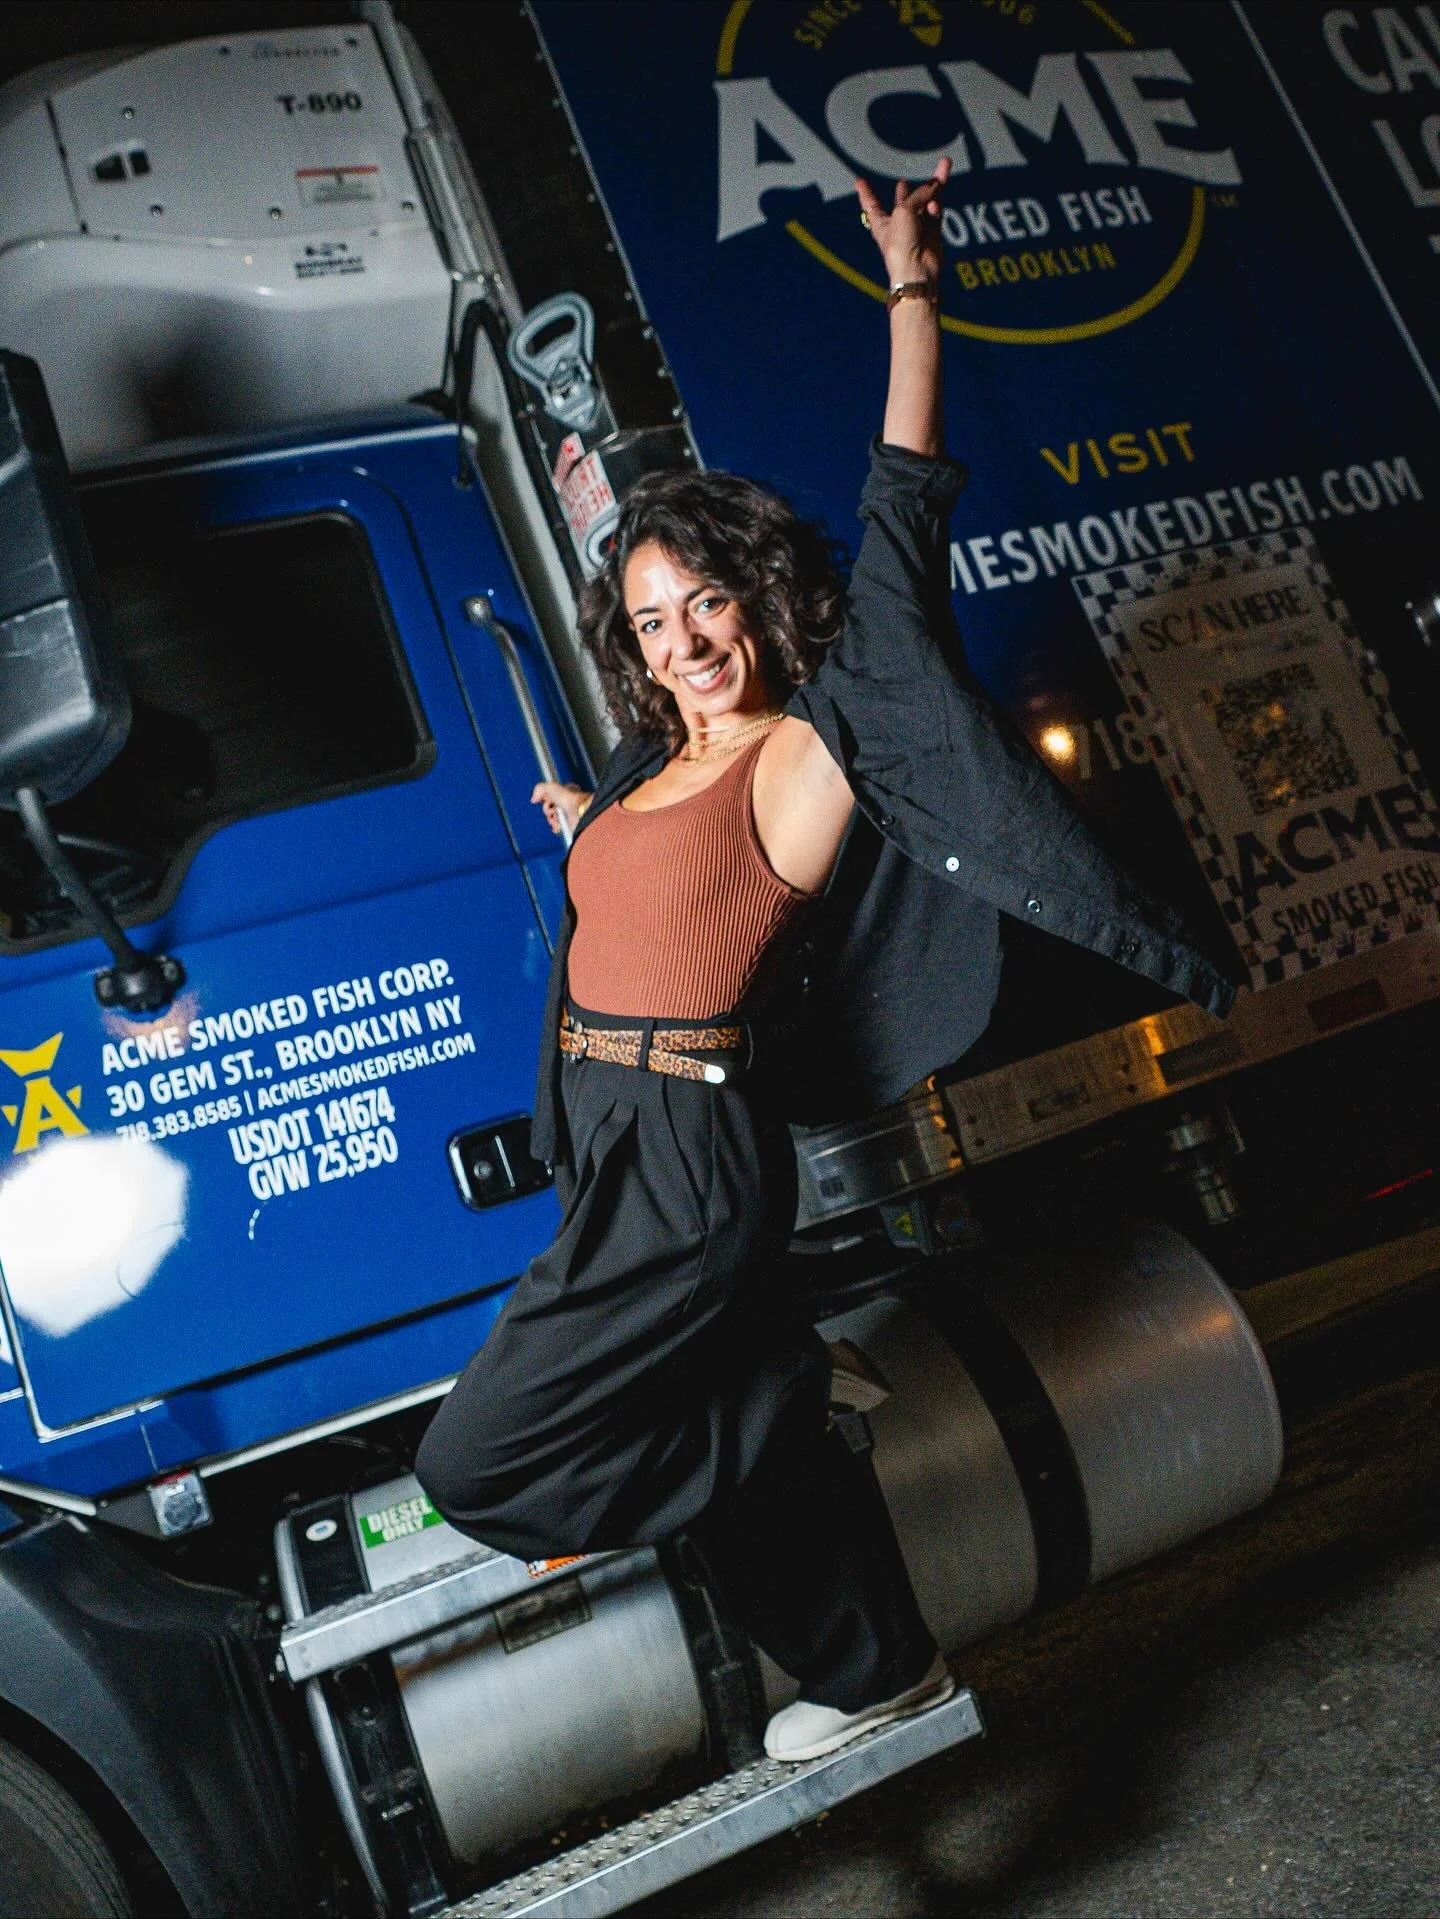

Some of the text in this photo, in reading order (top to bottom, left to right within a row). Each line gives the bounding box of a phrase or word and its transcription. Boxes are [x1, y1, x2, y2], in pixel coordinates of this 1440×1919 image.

[278, 91, 362, 115] T-890
[713, 49, 1242, 243] ACME
[941, 185, 1153, 248] OKED FISH
[954, 242, 1116, 290] BROOKLYN
[1040, 422, 1199, 485] VISIT
[949, 456, 1423, 594] ESMOKEDFISH.COM
[1230, 585, 1310, 629] HERE
[1234, 784, 1440, 913] ACME
[1272, 861, 1439, 936] SMOKED FISH
[102, 957, 454, 1075] ACME SMOKED FISH CORP.
[106, 995, 463, 1117] 30 GEM ST., BROOKLYN NY
[115, 1094, 242, 1142] 718.383.8585
[257, 1032, 476, 1111] ACMESMOKEDFISH.COM
[227, 1086, 396, 1165] USDOT 141674
[248, 1126, 399, 1200] GVW 25,950
[367, 1496, 433, 1534] DIESEL
[382, 1518, 424, 1542] ONLY
